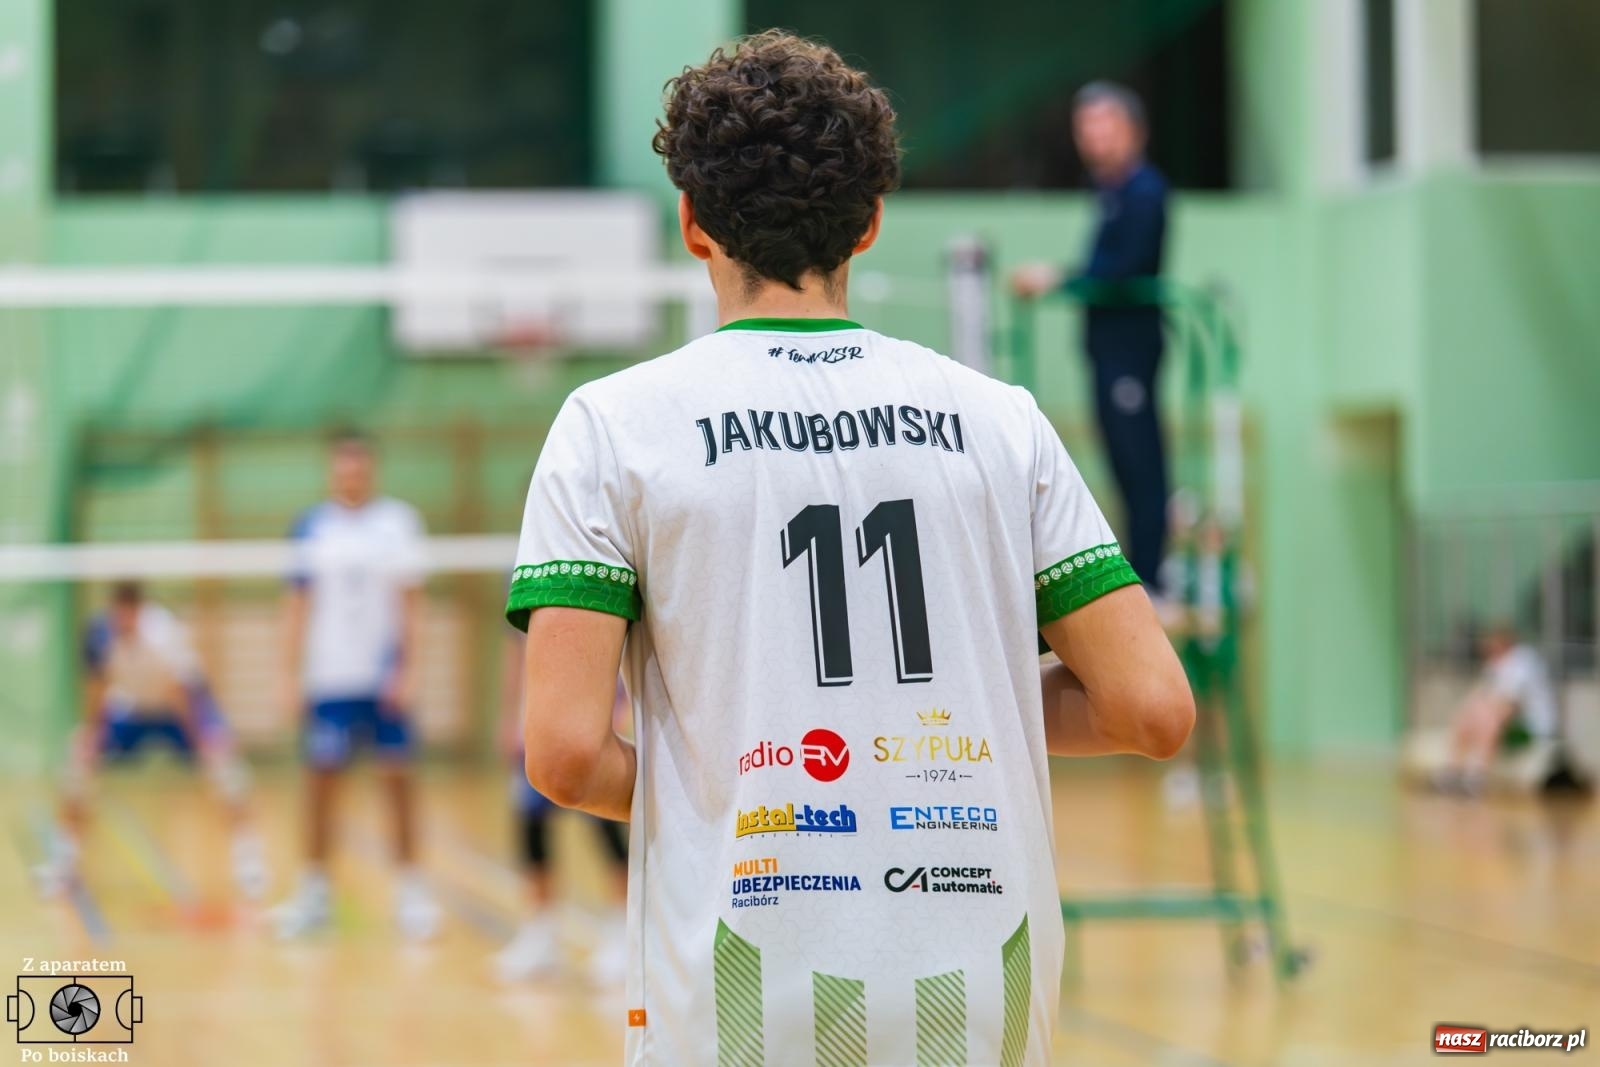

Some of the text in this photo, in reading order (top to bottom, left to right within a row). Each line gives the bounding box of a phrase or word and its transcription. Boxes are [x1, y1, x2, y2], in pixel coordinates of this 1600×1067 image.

[696, 404, 965, 467] JAKUBOWSKI
[780, 498, 934, 688] 11
[738, 740, 794, 776] radio
[873, 736, 993, 764] SZYPUŁA
[922, 769, 957, 783] 1974
[735, 802, 857, 831] instal-tech
[890, 806, 997, 830] ENTECO
[733, 857, 778, 878] MULTI
[931, 866, 992, 879] CONCEPT
[732, 875, 862, 895] UBEZPIECZENIA
[932, 880, 1003, 895] automatic
[732, 895, 779, 908] Racibórz
